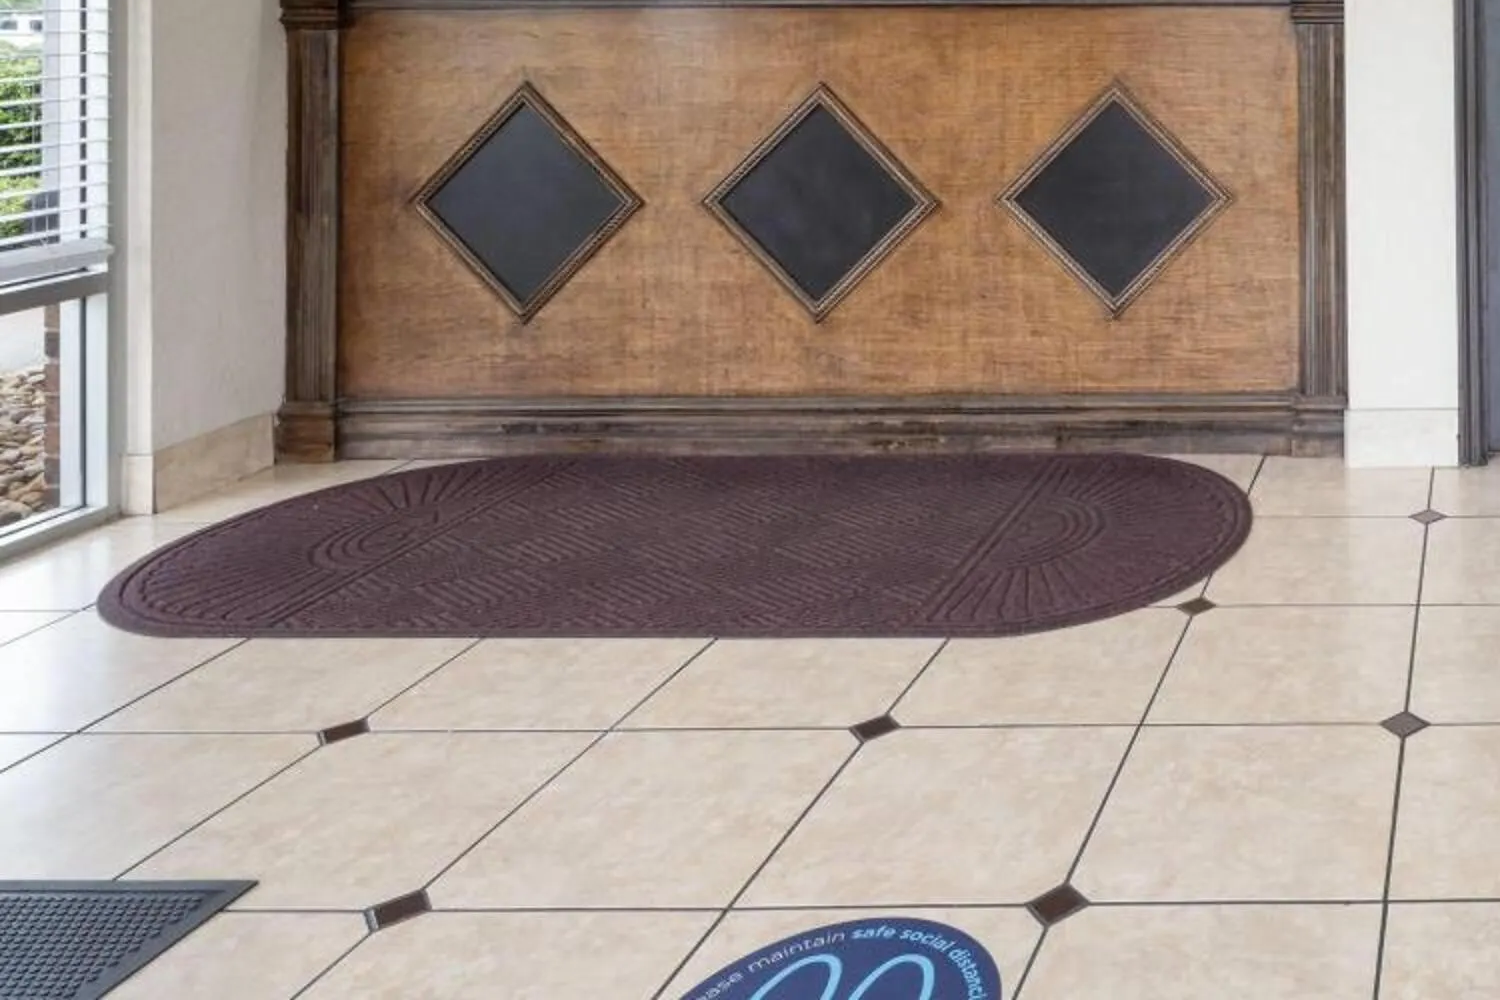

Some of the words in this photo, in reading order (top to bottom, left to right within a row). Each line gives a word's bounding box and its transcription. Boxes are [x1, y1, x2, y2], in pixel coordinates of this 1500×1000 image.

[696, 972, 743, 1000] ase
[747, 932, 846, 973] maintain
[851, 925, 897, 940] safe
[900, 928, 956, 952] social
[948, 948, 988, 1000] distanci
